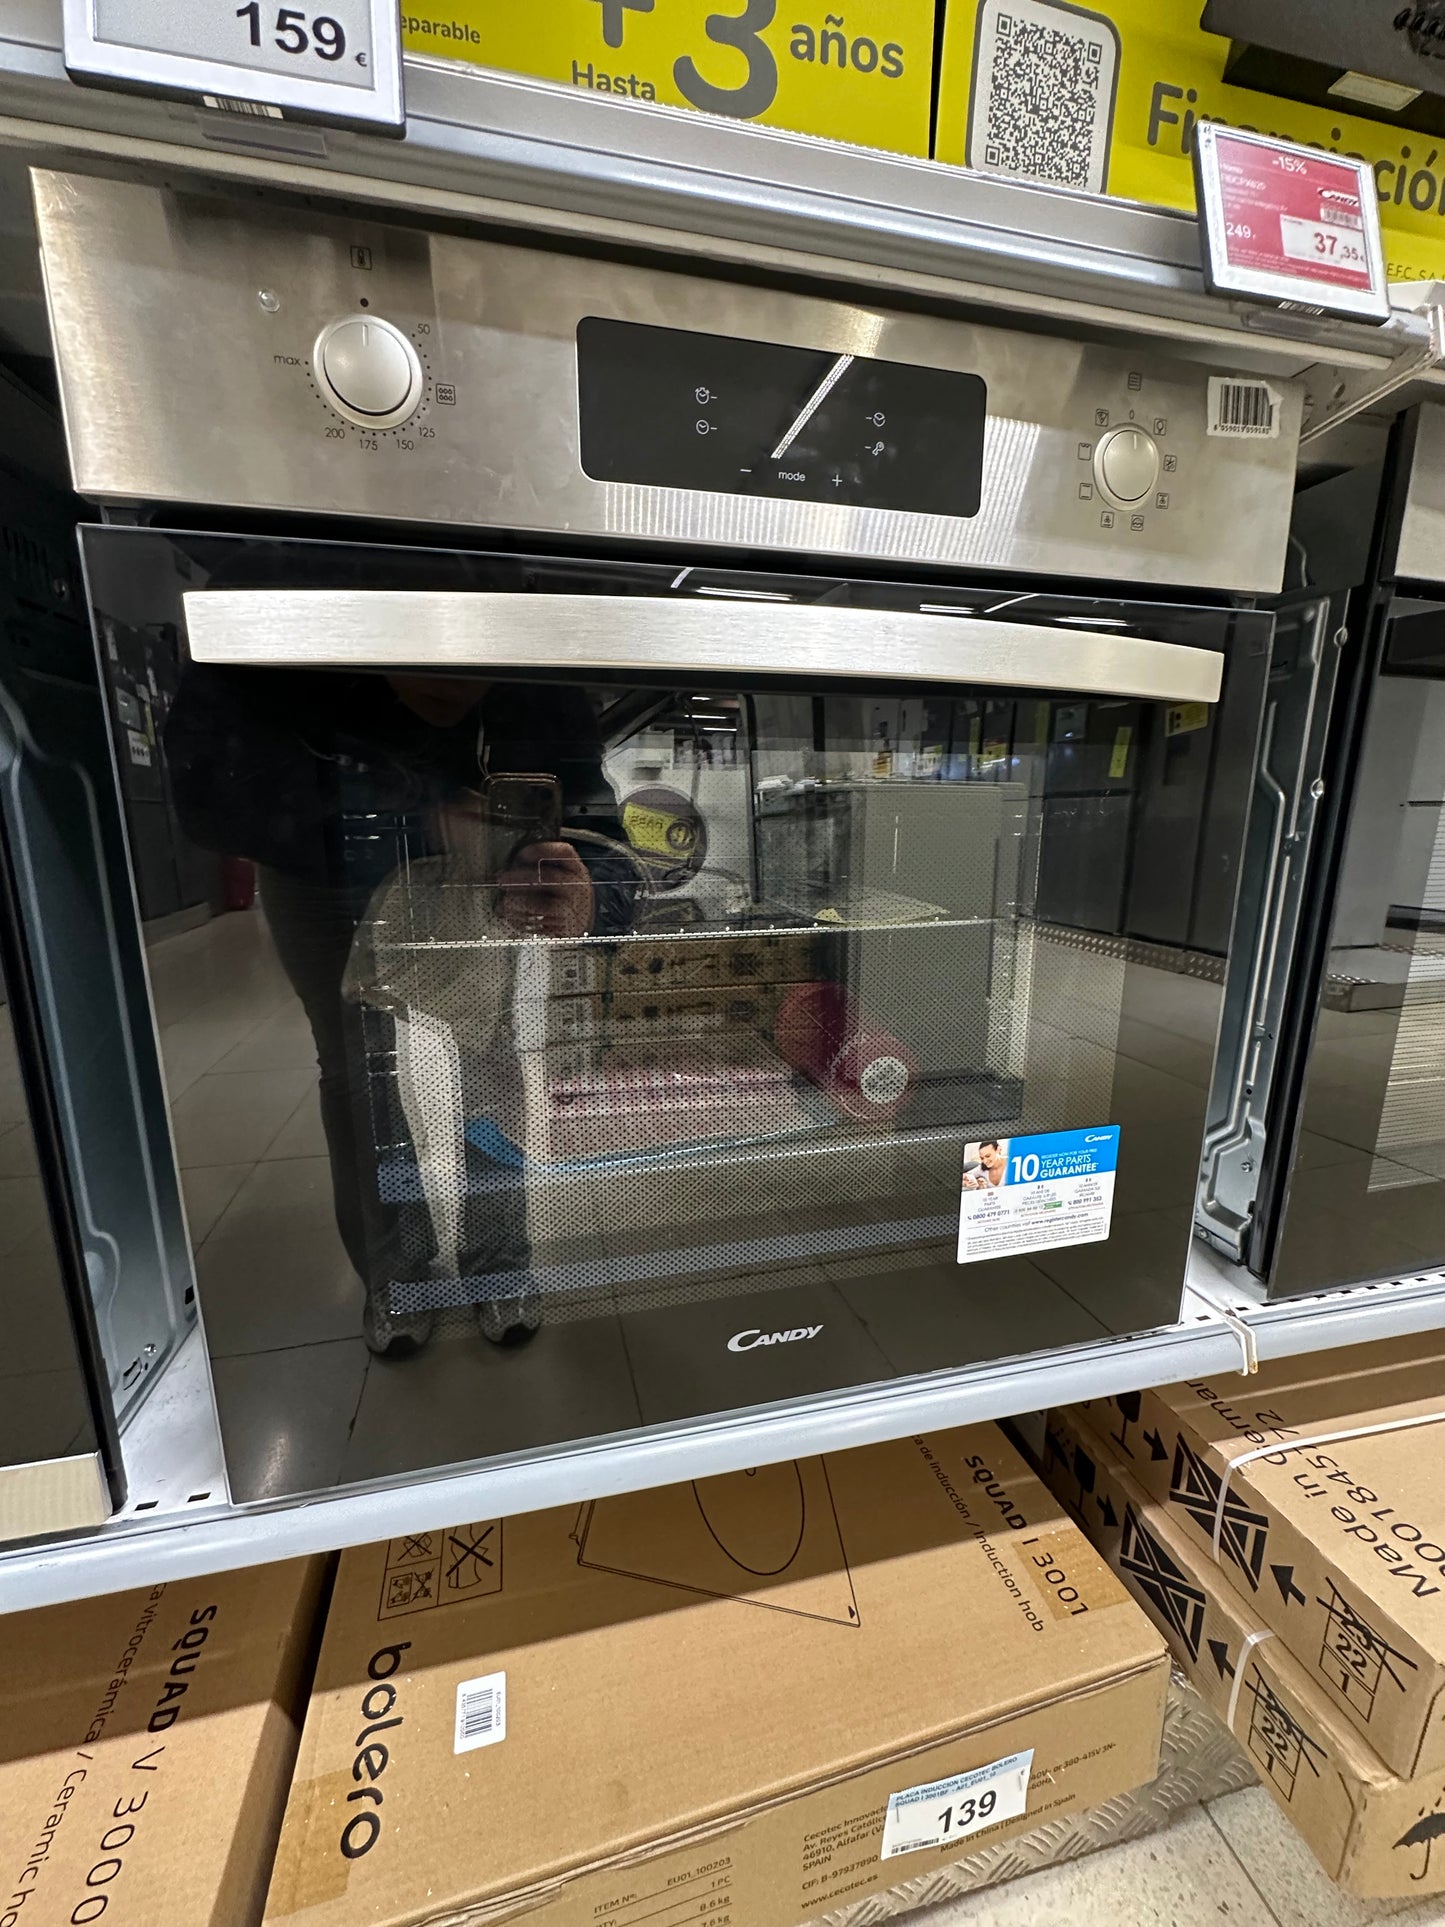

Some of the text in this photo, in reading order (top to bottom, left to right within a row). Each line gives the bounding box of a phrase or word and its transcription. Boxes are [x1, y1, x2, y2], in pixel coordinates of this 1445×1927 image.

[236, 1, 346, 62] 159
[401, 15, 480, 44] eparable
[790, 14, 906, 79] años
[572, 60, 656, 101] Hasta
[1272, 155, 1308, 175] -15%
[417, 323, 431, 335] 50
[273, 354, 302, 367] max
[325, 427, 346, 439] 200
[396, 438, 415, 451] 150
[418, 427, 436, 438] 125
[359, 439, 379, 451] 175
[778, 471, 806, 482] mode
[1011, 1154, 1040, 1183] 10
[1041, 1154, 1091, 1168] YEAR PARTS
[727, 1324, 824, 1352] CANDY
[1293, 1474, 1327, 1498] in
[930, 1460, 971, 1519] inducción
[973, 1530, 1022, 1598] Induction
[1018, 1600, 1044, 1632] hob
[964, 1454, 1028, 1530] SQUAD
[1032, 1552, 1089, 1617] 3001
[1331, 1506, 1440, 1598] Made
[82, 1602, 159, 1744] vitrocerámica
[340, 1641, 412, 1859] bolero
[70, 1605, 218, 1926] SQUAD V 3000
[1053, 1764, 1062, 1773] or
[895, 1756, 1018, 1800] PLACA INDUCCION CECOTEC BOLERO
[895, 1796, 920, 1807] SQUAD
[937, 1790, 998, 1834] 139
[19, 1768, 88, 1884] Ceramic
[804, 1822, 842, 1842] Cecotec
[940, 1839, 964, 1853] Made
[965, 1835, 975, 1844] in
[975, 1825, 999, 1840] China
[1005, 1806, 1043, 1827] Designed
[1044, 1801, 1052, 1810] in
[1053, 1793, 1076, 1809] Spain
[803, 1842, 817, 1851] Av.
[820, 1827, 848, 1846] Reyes
[836, 1832, 869, 1849] Alfafar
[802, 1854, 832, 1872] SPAIN
[717, 1875, 731, 1886] PC
[801, 1873, 879, 1909] www.cecotec.es
[594, 1898, 620, 1914] ITEM
[718, 1895, 731, 1904] kg
